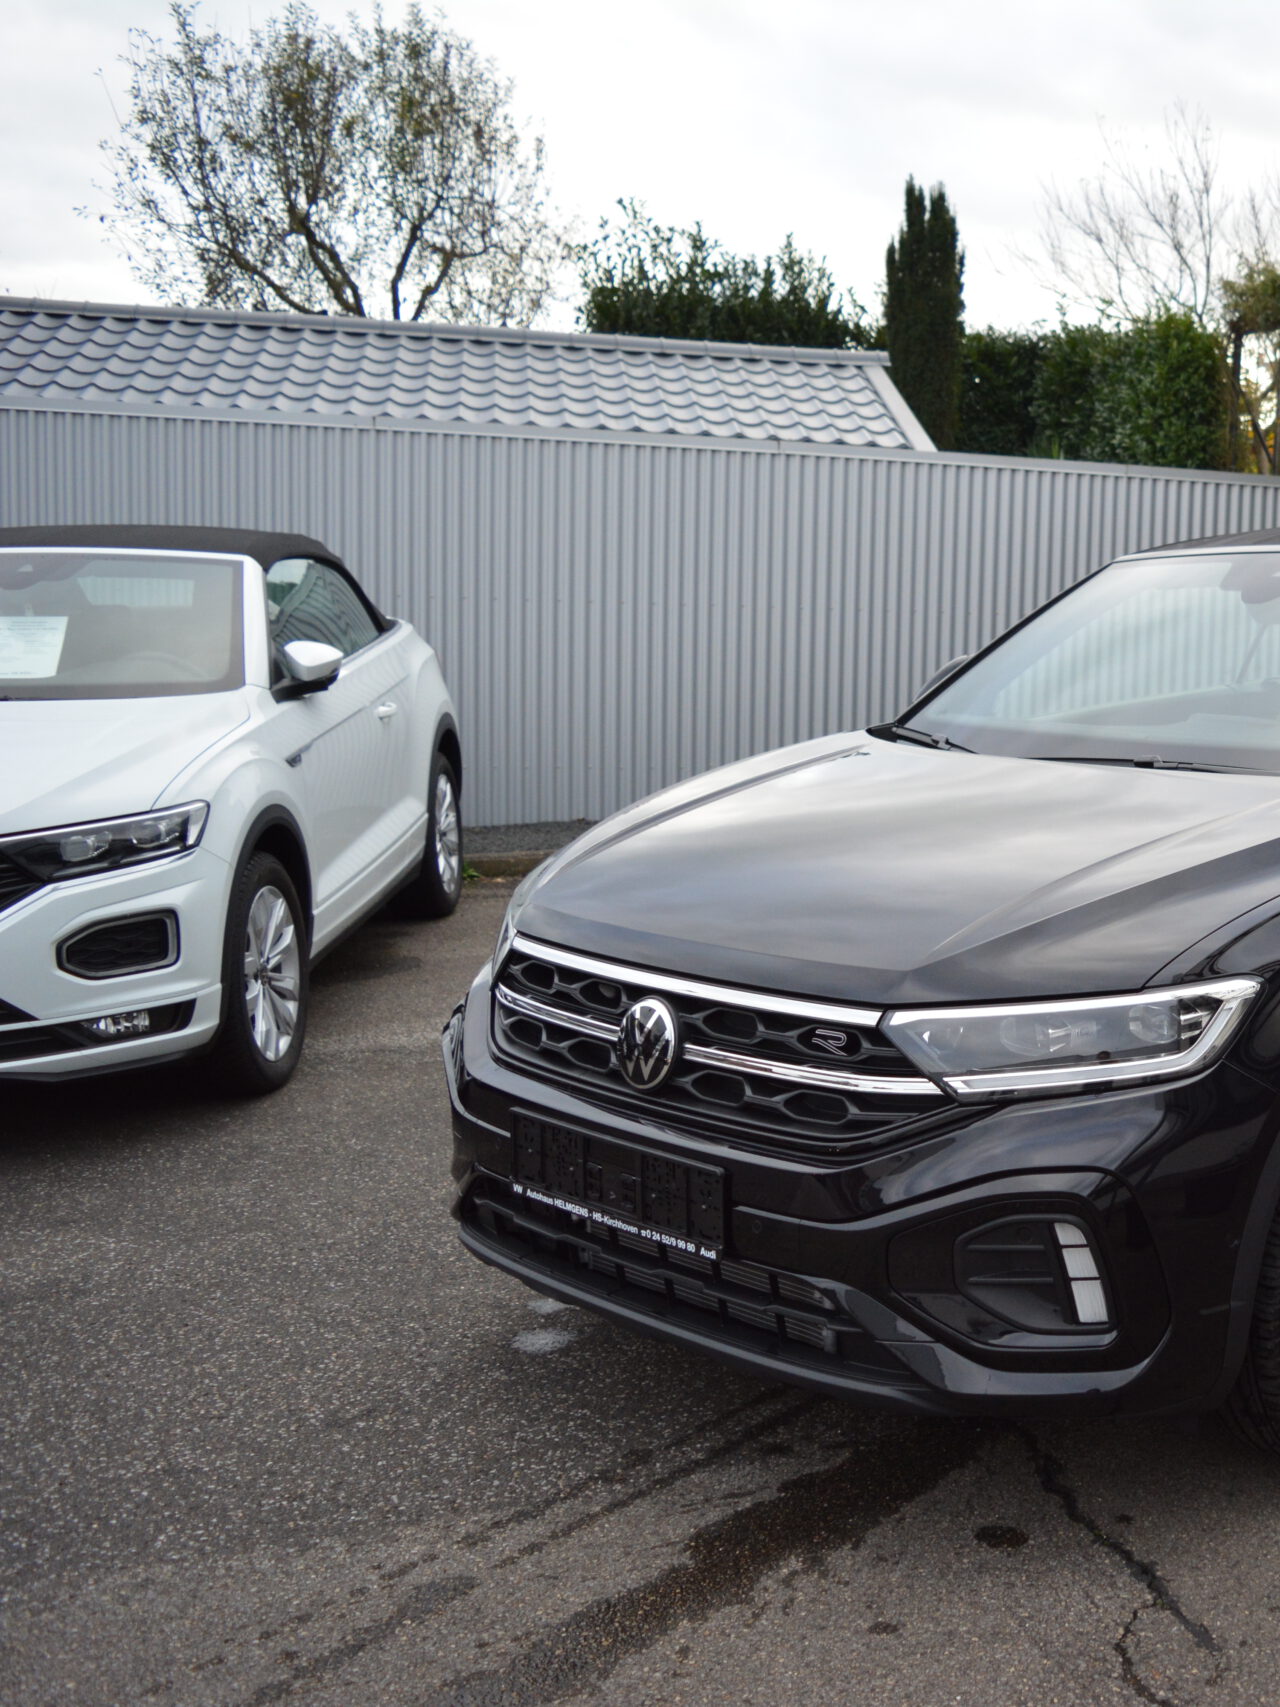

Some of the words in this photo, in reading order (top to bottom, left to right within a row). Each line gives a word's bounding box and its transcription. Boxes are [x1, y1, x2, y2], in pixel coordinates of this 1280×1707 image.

[512, 1183, 523, 1194] VW
[526, 1189, 554, 1205] Autohaus
[592, 1211, 638, 1234] HS-Kirchhoven
[700, 1247, 717, 1259] Audi
